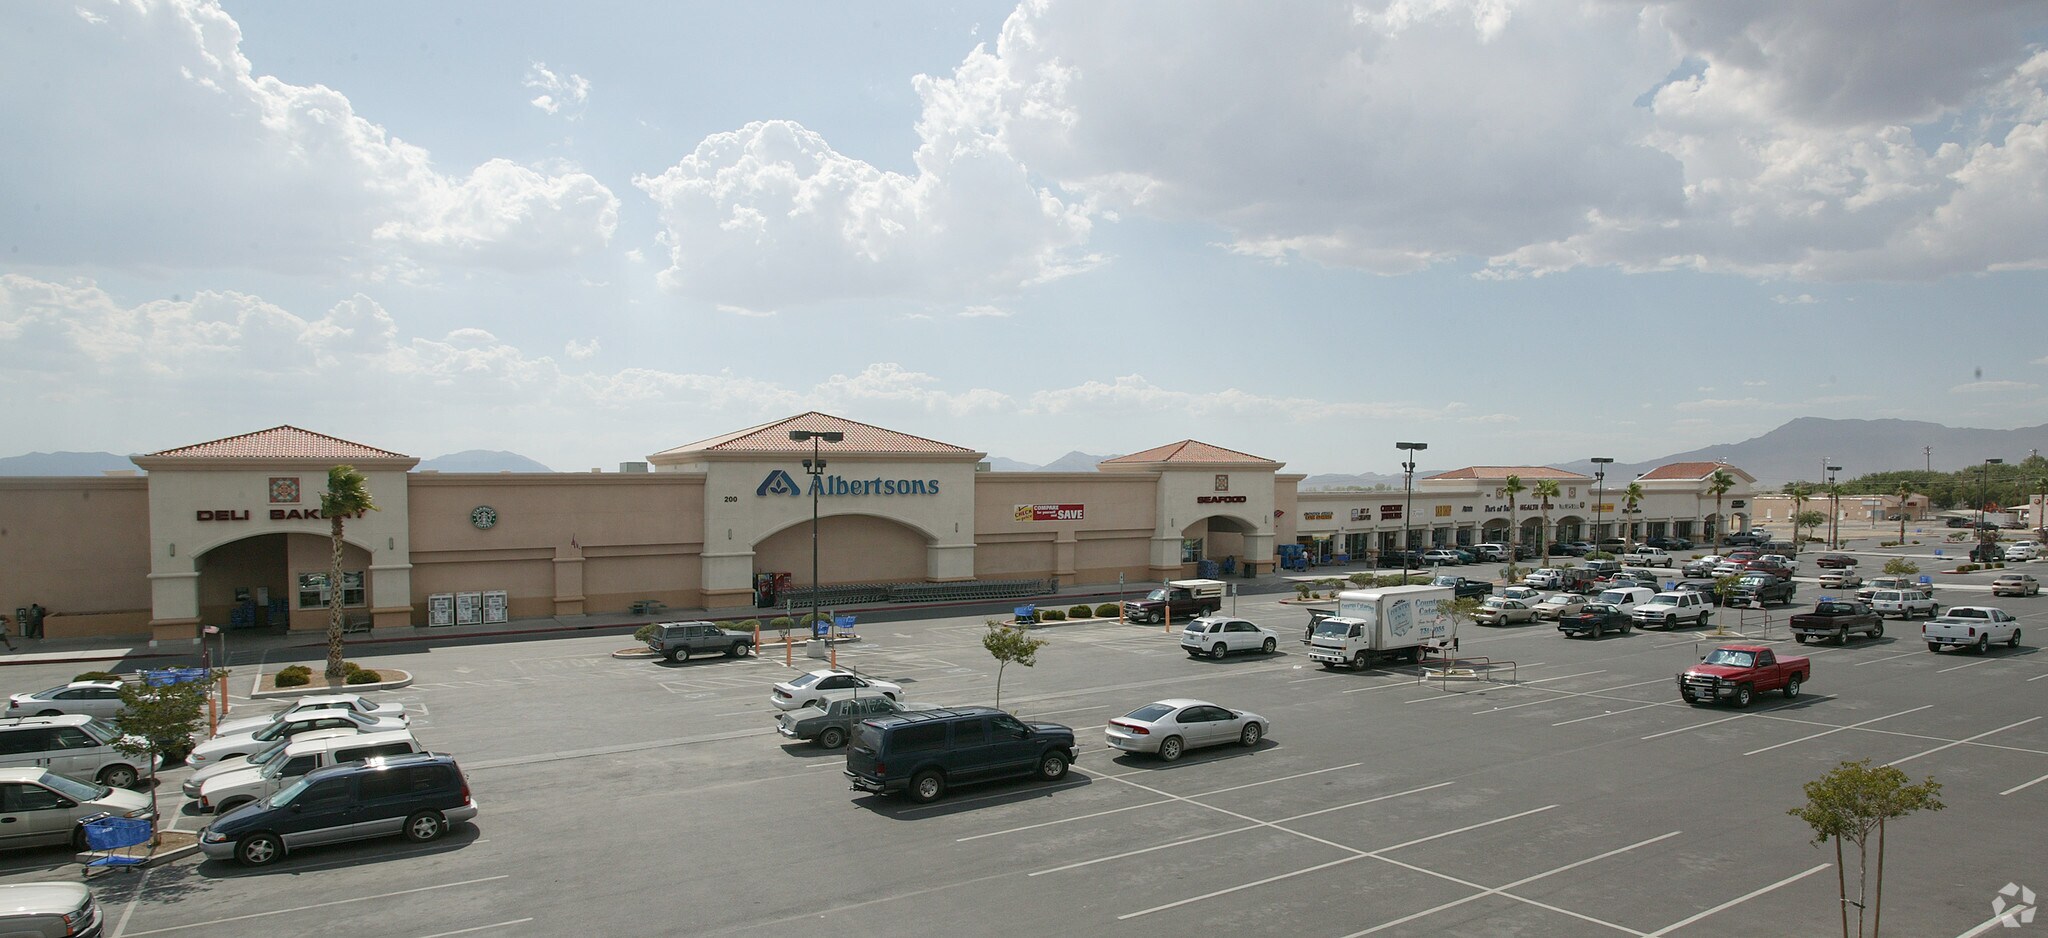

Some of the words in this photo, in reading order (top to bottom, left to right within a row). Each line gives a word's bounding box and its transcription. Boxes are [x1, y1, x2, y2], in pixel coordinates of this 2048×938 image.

[808, 475, 939, 495] Albertsons
[724, 495, 738, 503] 200
[1197, 496, 1247, 504] SEAFOOD
[196, 510, 250, 521] DELI
[1057, 509, 1083, 520] SAVE
